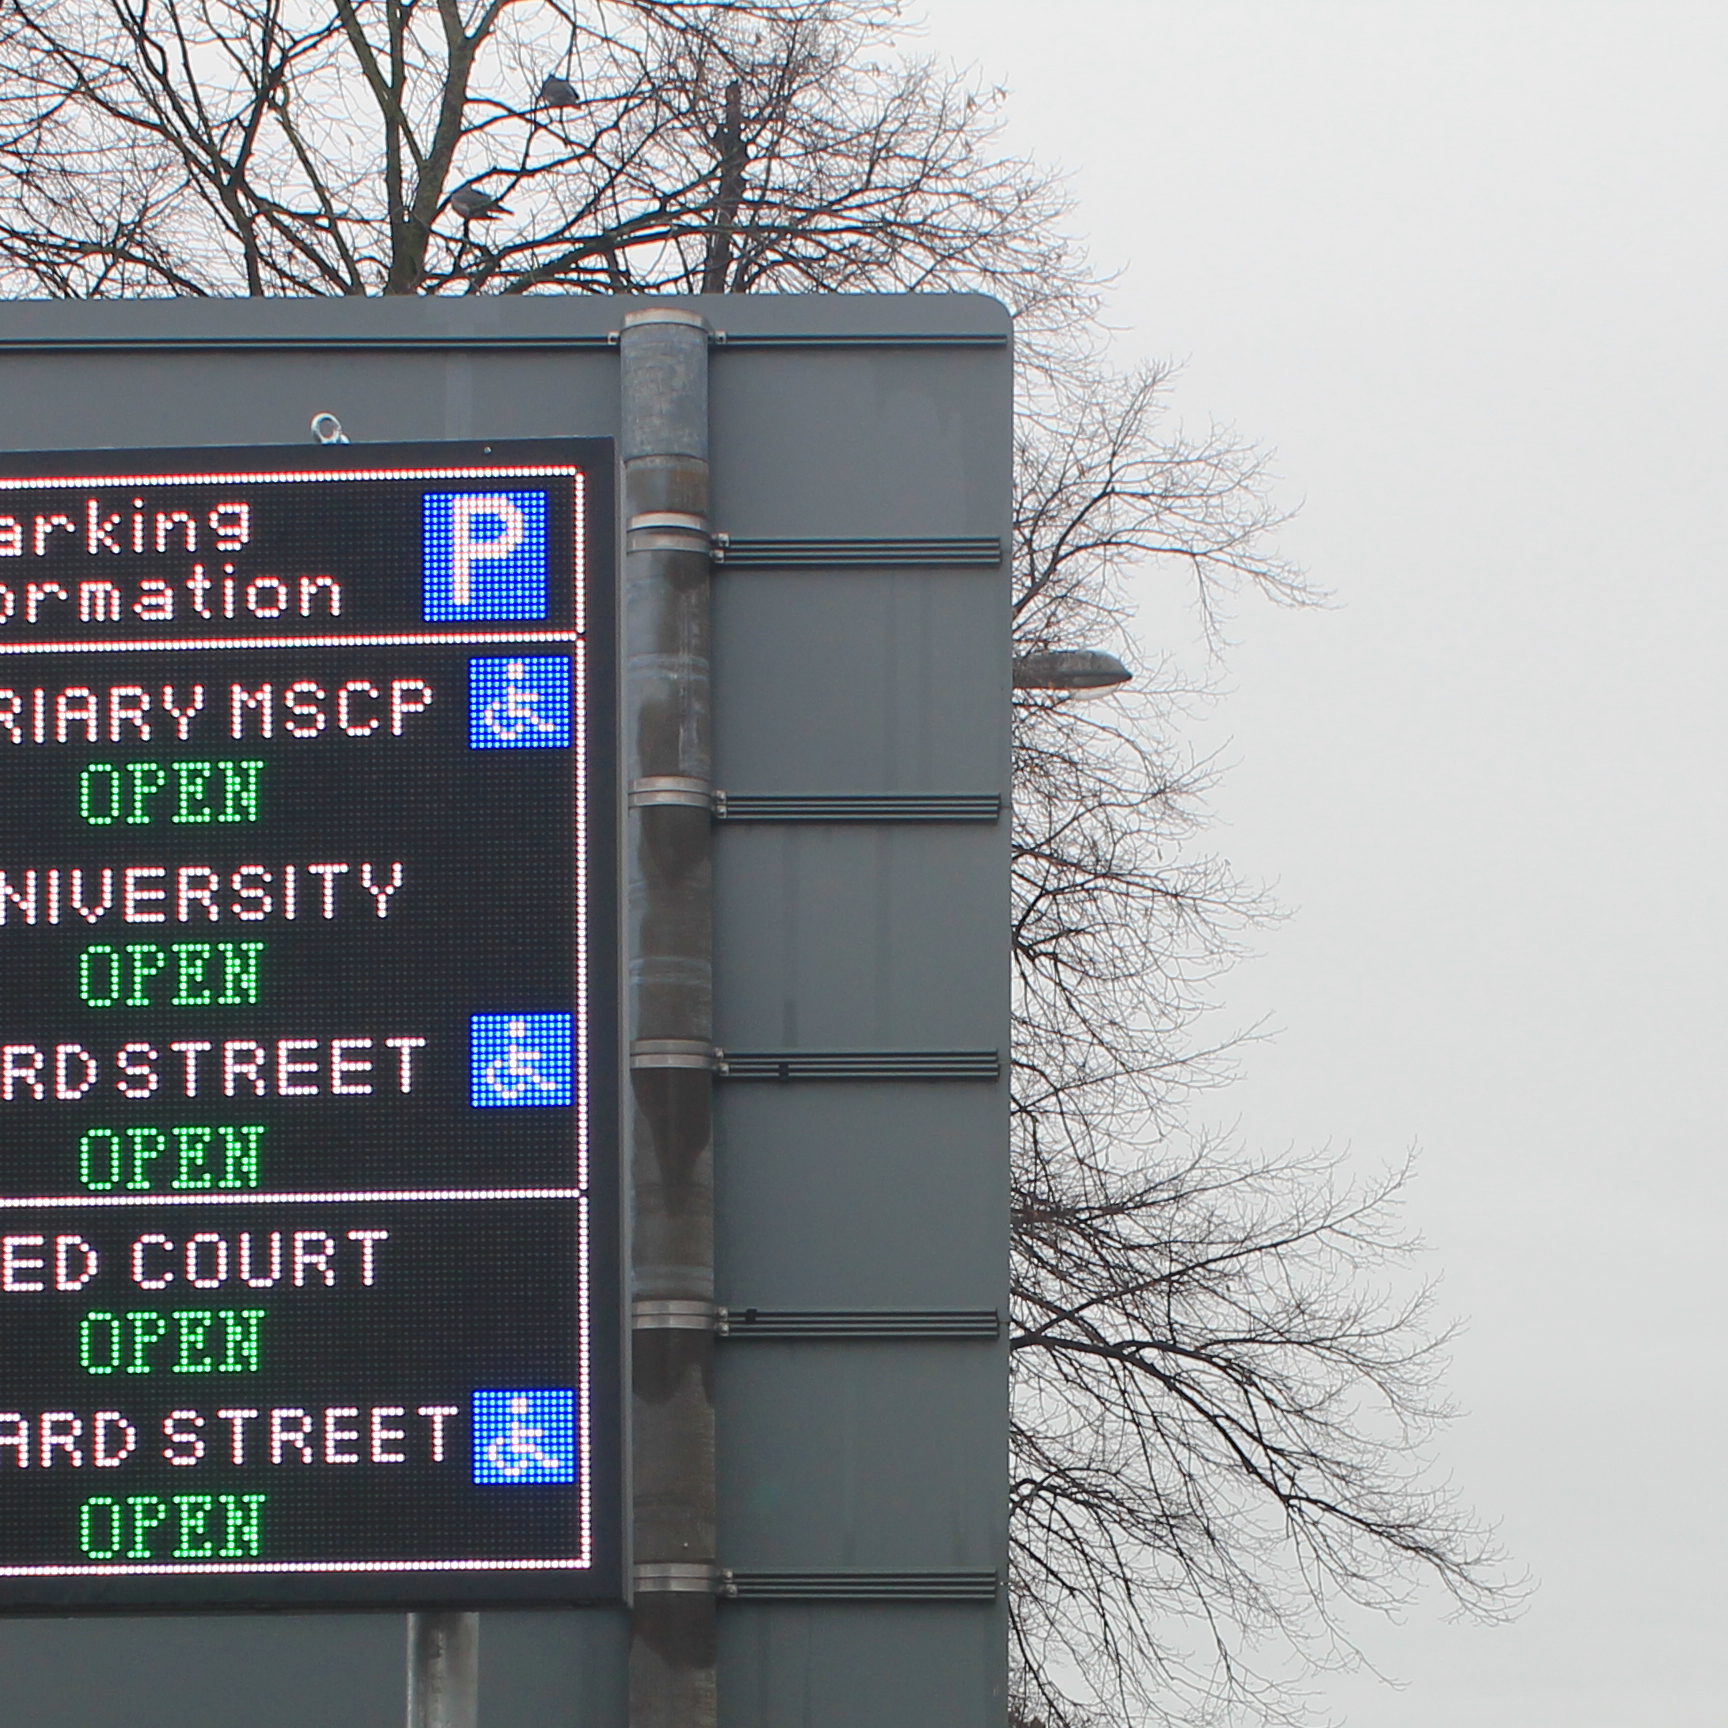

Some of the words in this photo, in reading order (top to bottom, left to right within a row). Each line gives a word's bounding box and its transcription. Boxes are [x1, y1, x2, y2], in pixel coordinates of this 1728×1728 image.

[451, 493, 527, 607] P
[230, 680, 433, 740] MSCP
[79, 760, 265, 825] OPEN
[79, 941, 265, 1008] OPEN
[116, 1037, 427, 1099] STREET
[79, 1125, 266, 1191] OPEN
[132, 1230, 390, 1290] COURT
[79, 1309, 267, 1375] OPEN
[163, 1406, 460, 1466] STREET
[79, 1493, 267, 1560] OPEN
